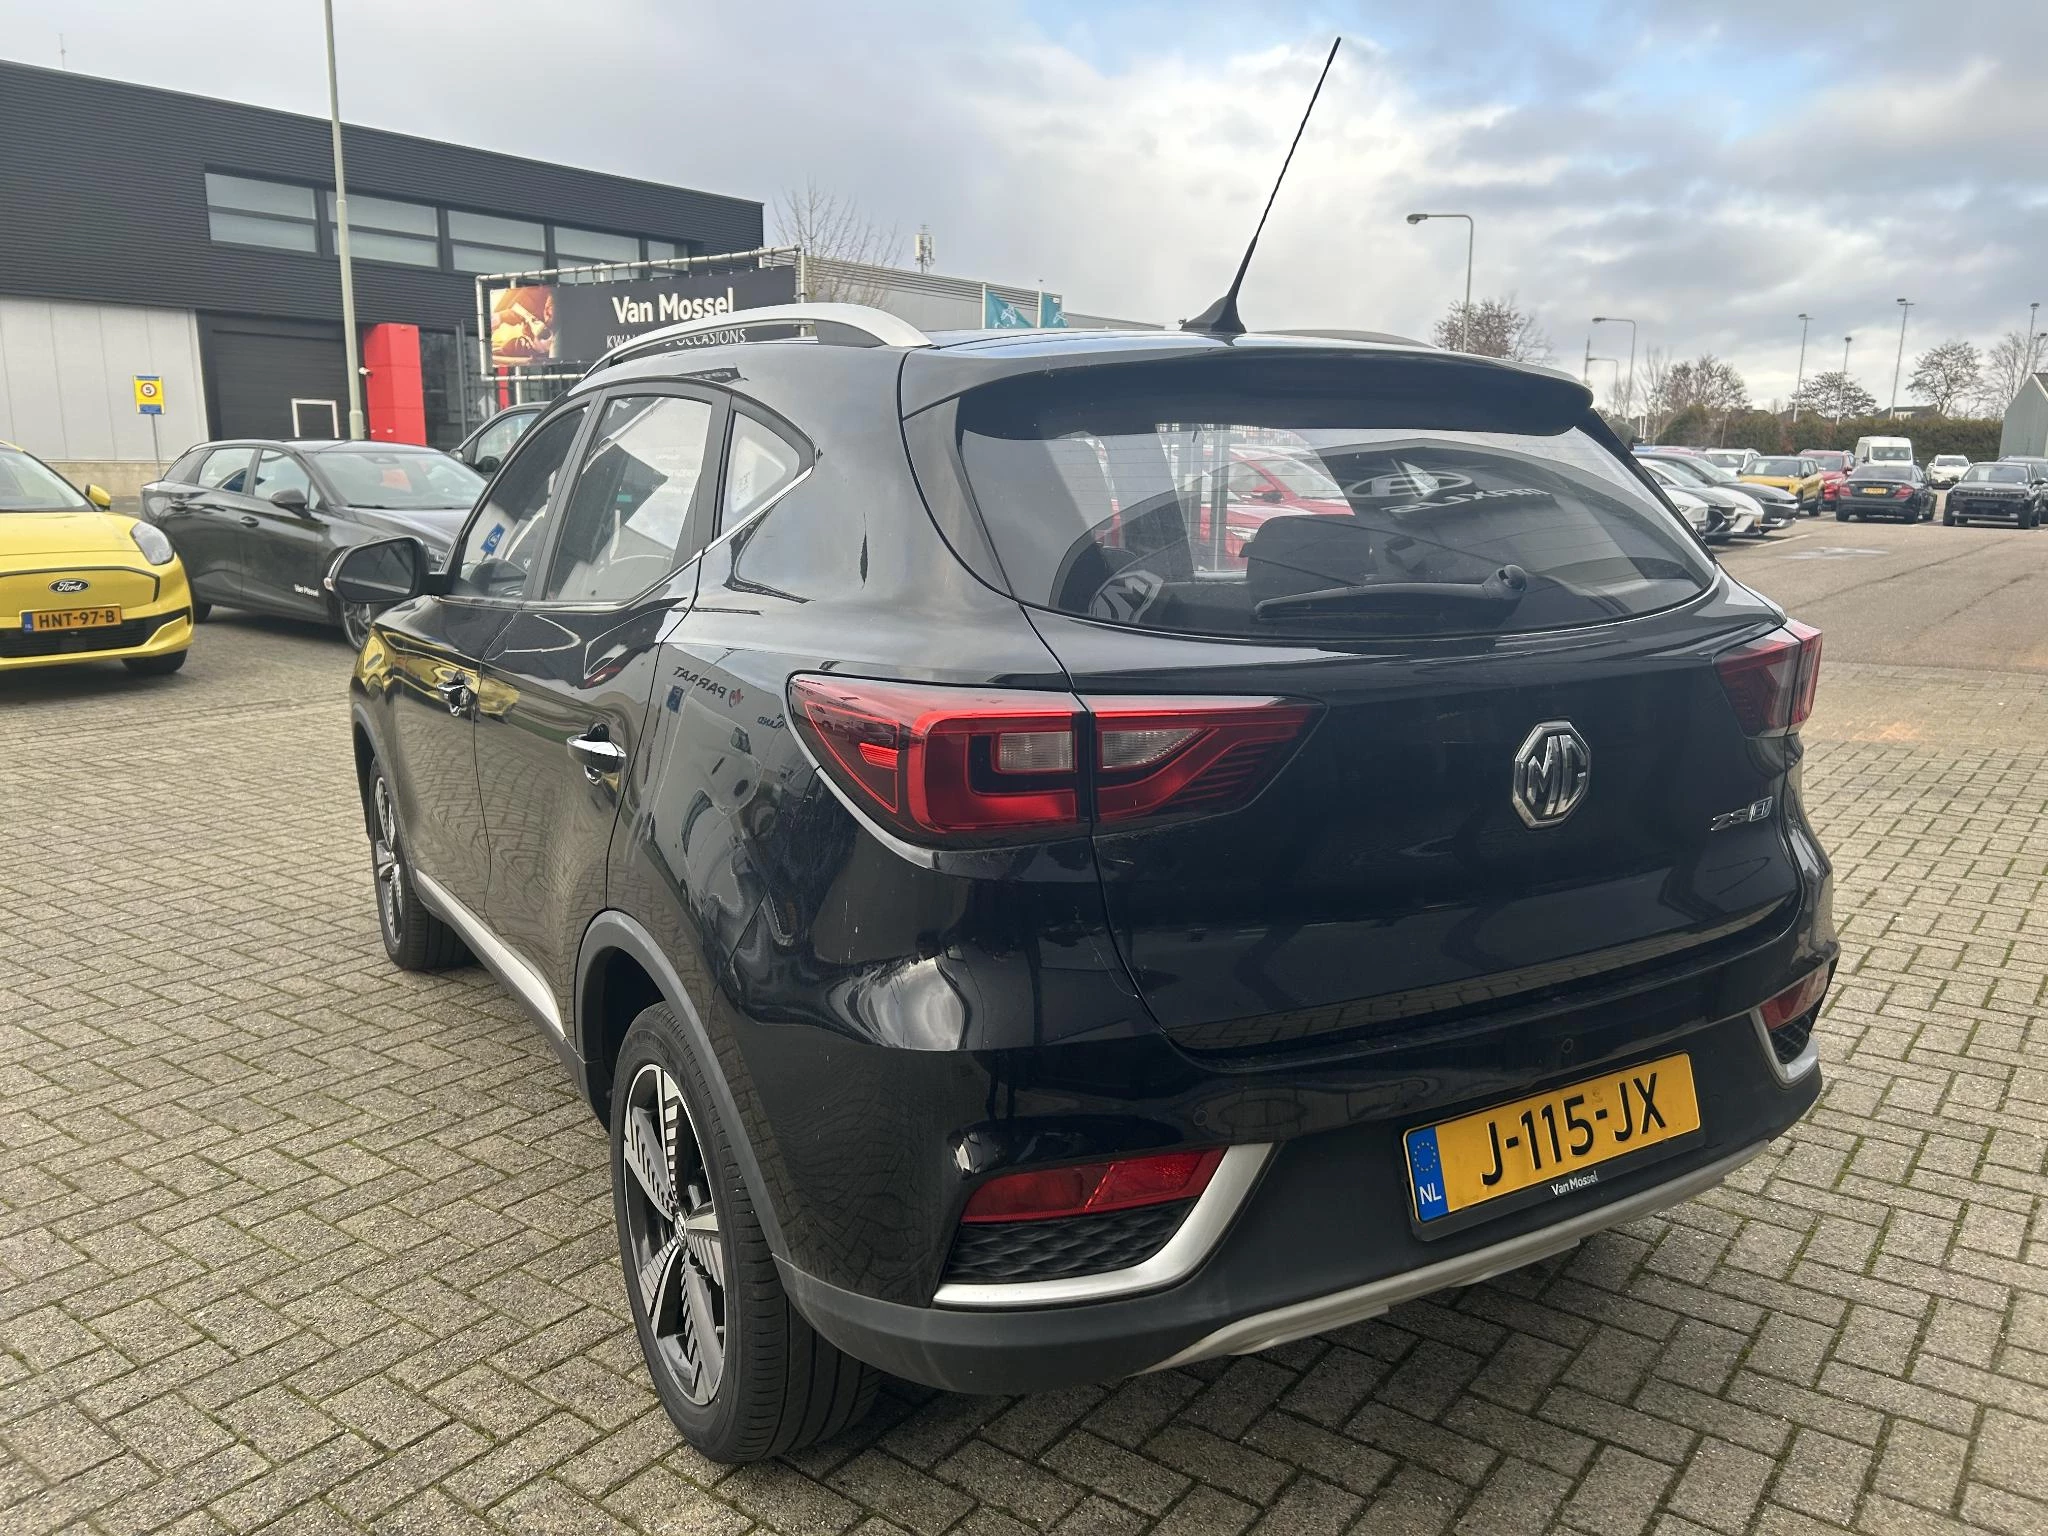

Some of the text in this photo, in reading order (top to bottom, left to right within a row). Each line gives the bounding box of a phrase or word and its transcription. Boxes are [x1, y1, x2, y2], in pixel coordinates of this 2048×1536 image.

[612, 287, 734, 325] Van Mossel
[145, 386, 152, 394] 5
[57, 581, 82, 592] Ford
[38, 609, 115, 629] HNT-97-B
[1524, 732, 1589, 818] MG
[1480, 1072, 1667, 1187] J-115-JX
[1418, 1182, 1442, 1206] NL
[1550, 1170, 1599, 1196] Van Mossel
